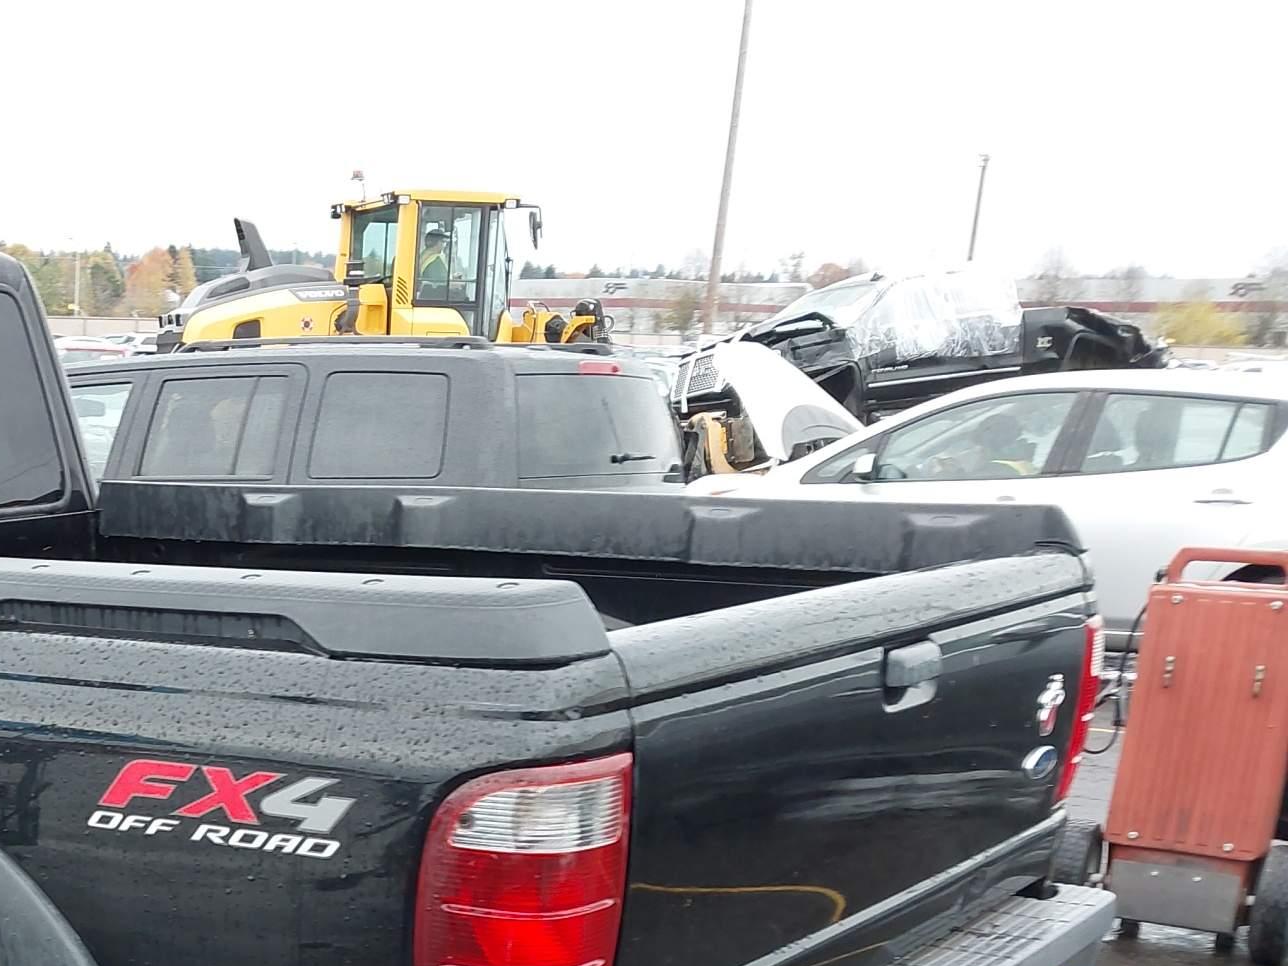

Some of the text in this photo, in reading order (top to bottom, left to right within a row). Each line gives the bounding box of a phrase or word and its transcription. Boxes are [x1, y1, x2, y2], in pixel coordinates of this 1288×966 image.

[97, 758, 357, 834] FX4
[87, 810, 341, 858] OFF ROAD
